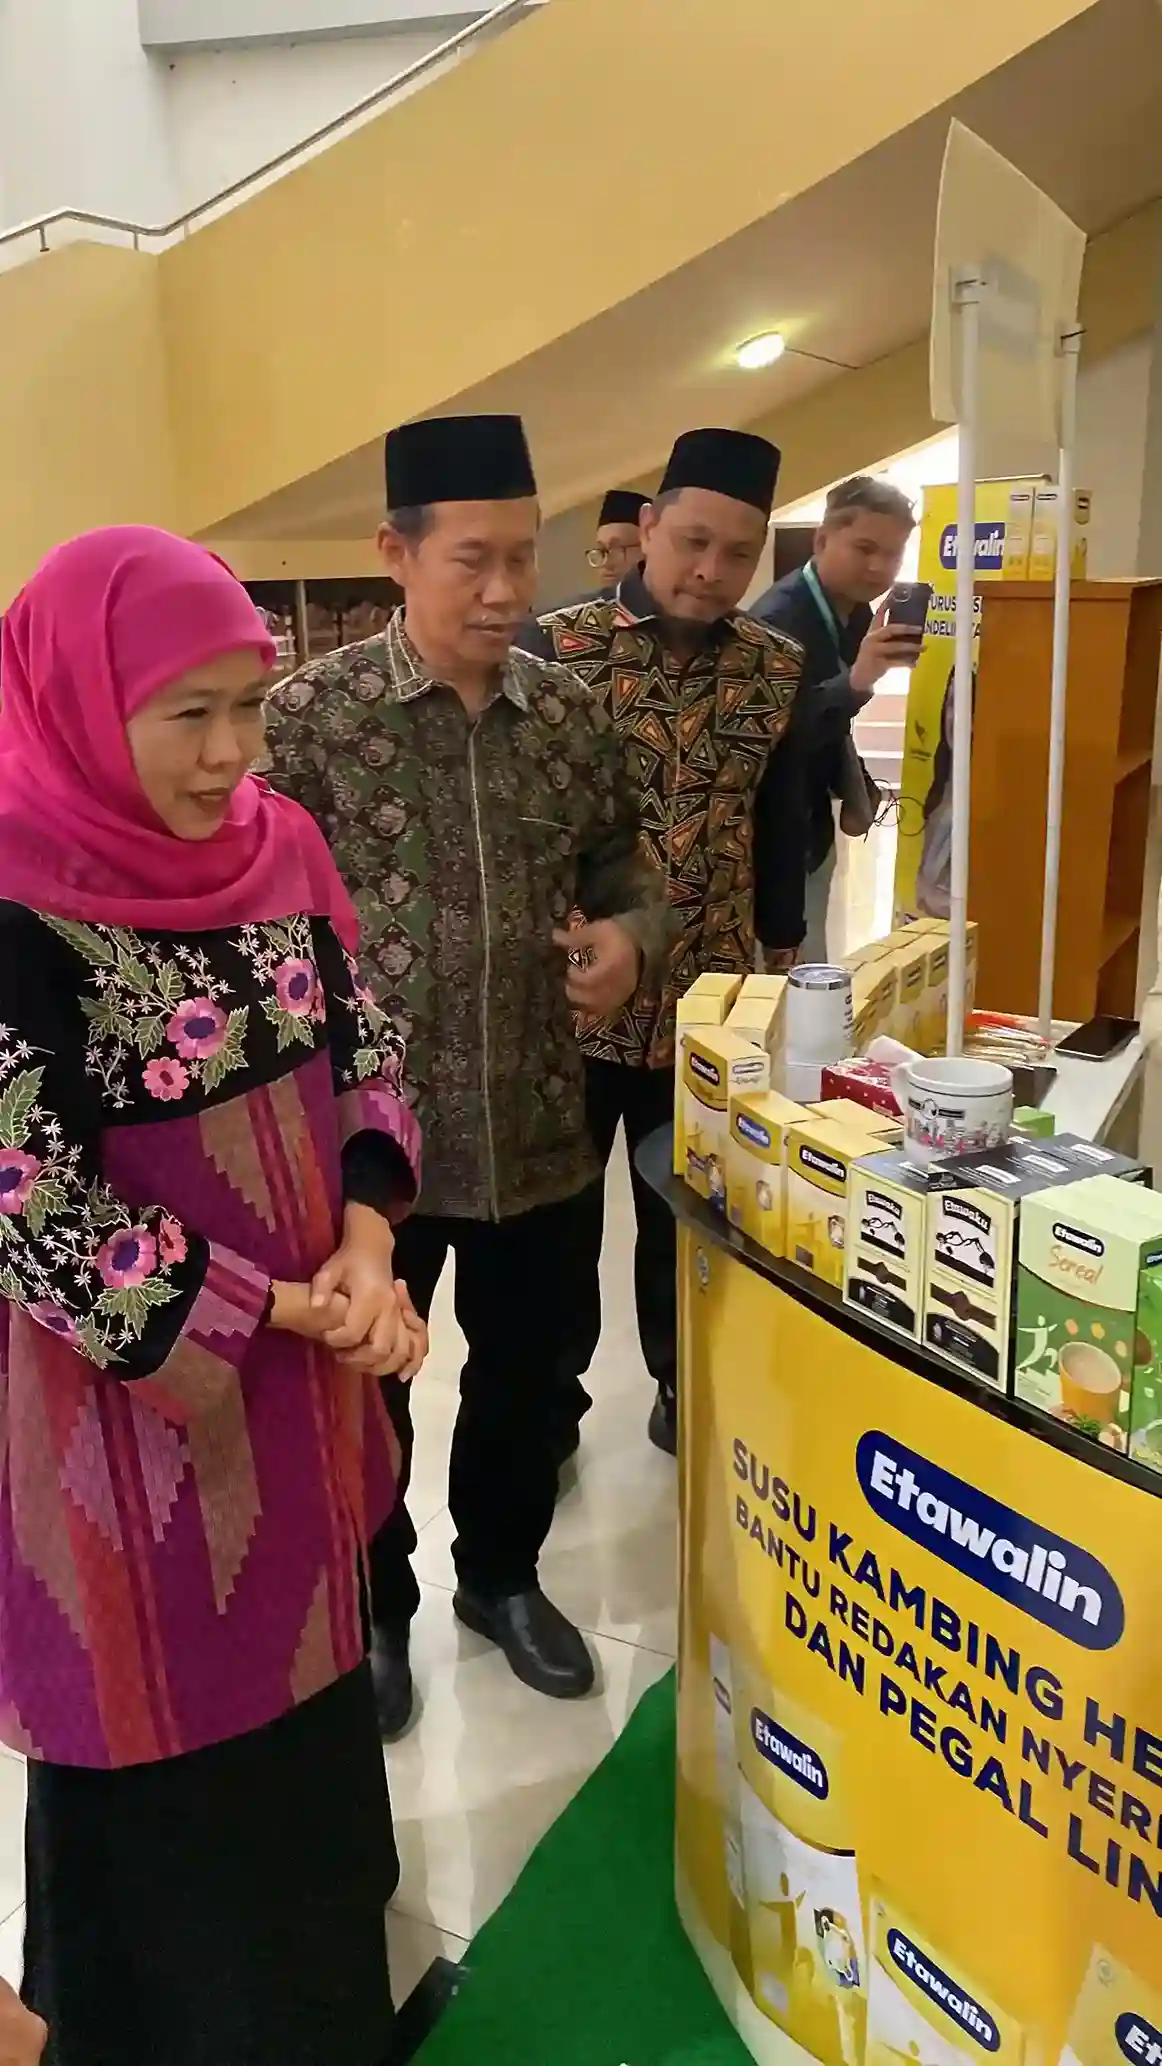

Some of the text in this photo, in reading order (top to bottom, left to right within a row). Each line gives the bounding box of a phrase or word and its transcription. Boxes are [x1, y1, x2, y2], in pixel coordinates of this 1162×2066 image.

[929, 595, 957, 611] URUS
[1047, 1244, 1104, 1285] Sereal
[733, 1437, 816, 1542] SUSU
[829, 1521, 1063, 1720] KAMBING
[870, 1449, 1102, 1626] Etawalin
[736, 1494, 820, 1598] BANTU
[830, 1584, 1006, 1744] REDAKAN
[755, 1716, 824, 1788] Etawalin
[785, 1591, 865, 1692] DAN
[880, 1673, 1048, 1838] PEGAL
[892, 1937, 993, 2043] Etawalin
